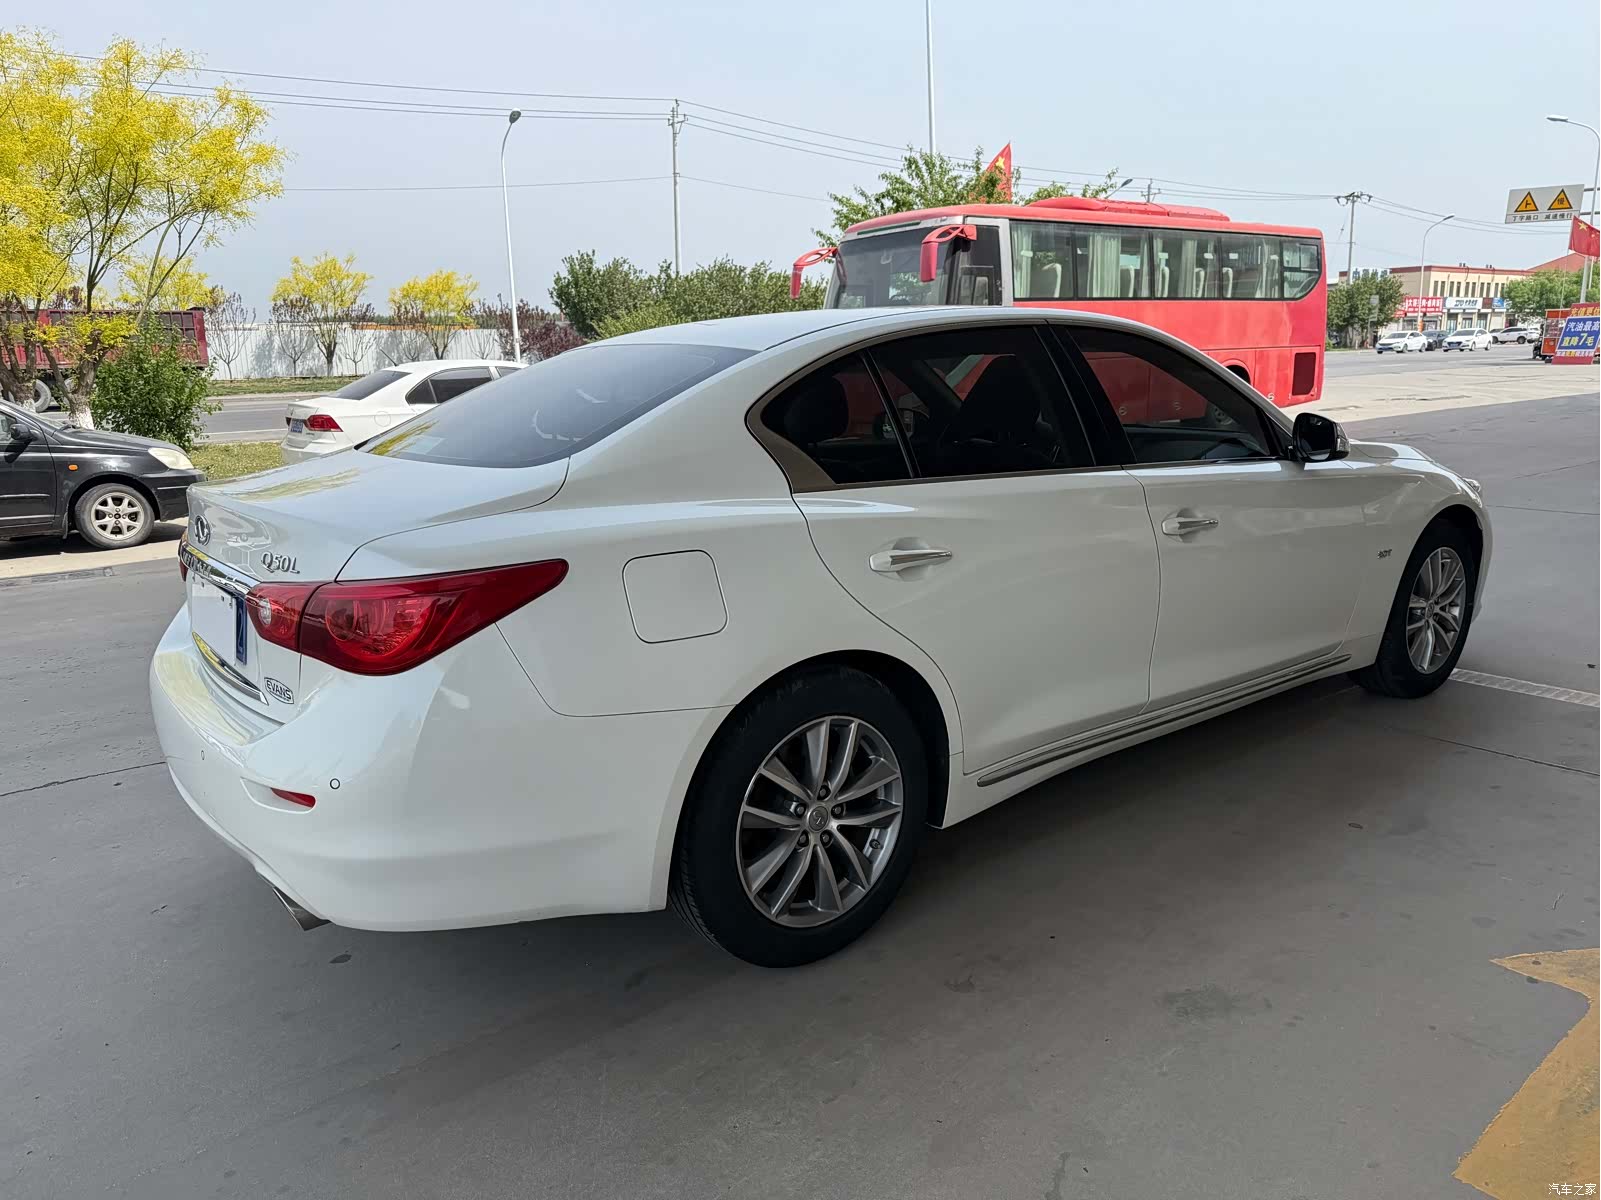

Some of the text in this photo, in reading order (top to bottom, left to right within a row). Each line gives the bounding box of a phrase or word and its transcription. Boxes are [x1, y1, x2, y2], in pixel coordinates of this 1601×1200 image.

[1512, 212, 1573, 222] 丁字路口 减速慢行
[1566, 320, 1600, 332] 汽油最高
[1560, 332, 1595, 347] 直降7毛
[260, 551, 301, 574] Q50L
[266, 679, 292, 700] EVANS
